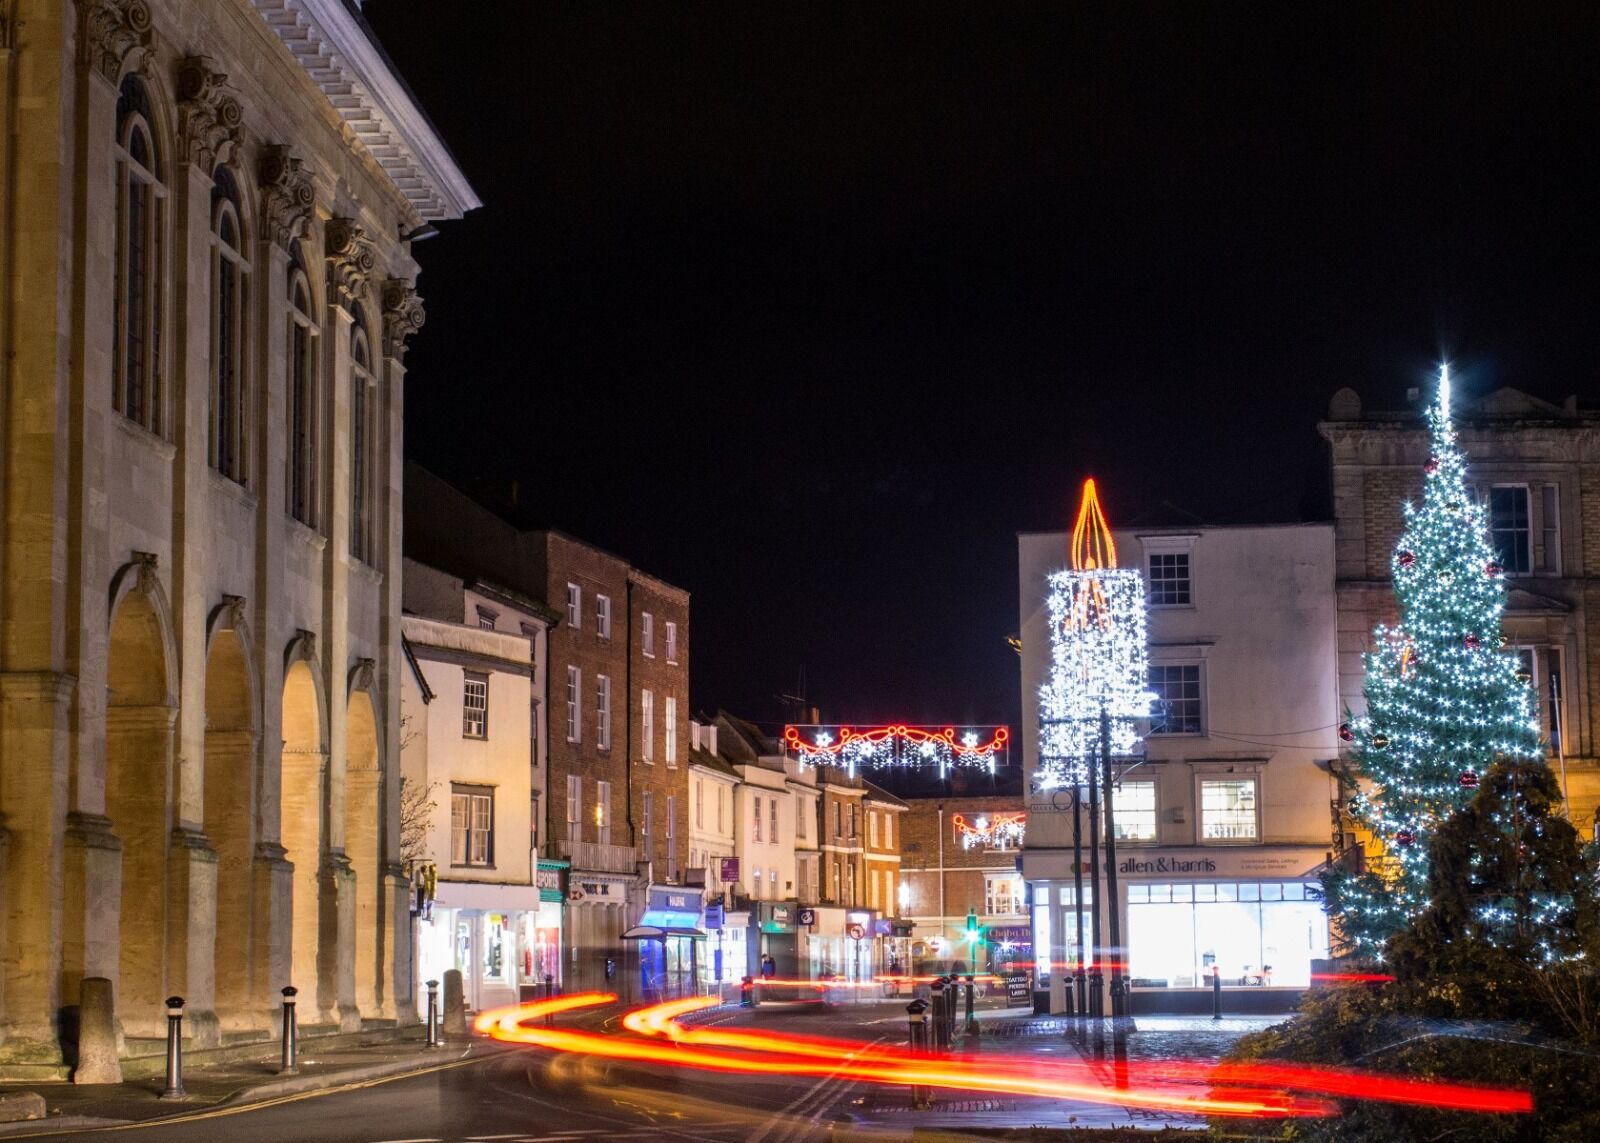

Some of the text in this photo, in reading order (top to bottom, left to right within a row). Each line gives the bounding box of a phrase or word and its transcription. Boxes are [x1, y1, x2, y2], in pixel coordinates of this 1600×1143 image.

[1119, 857, 1216, 873] allen & harris
